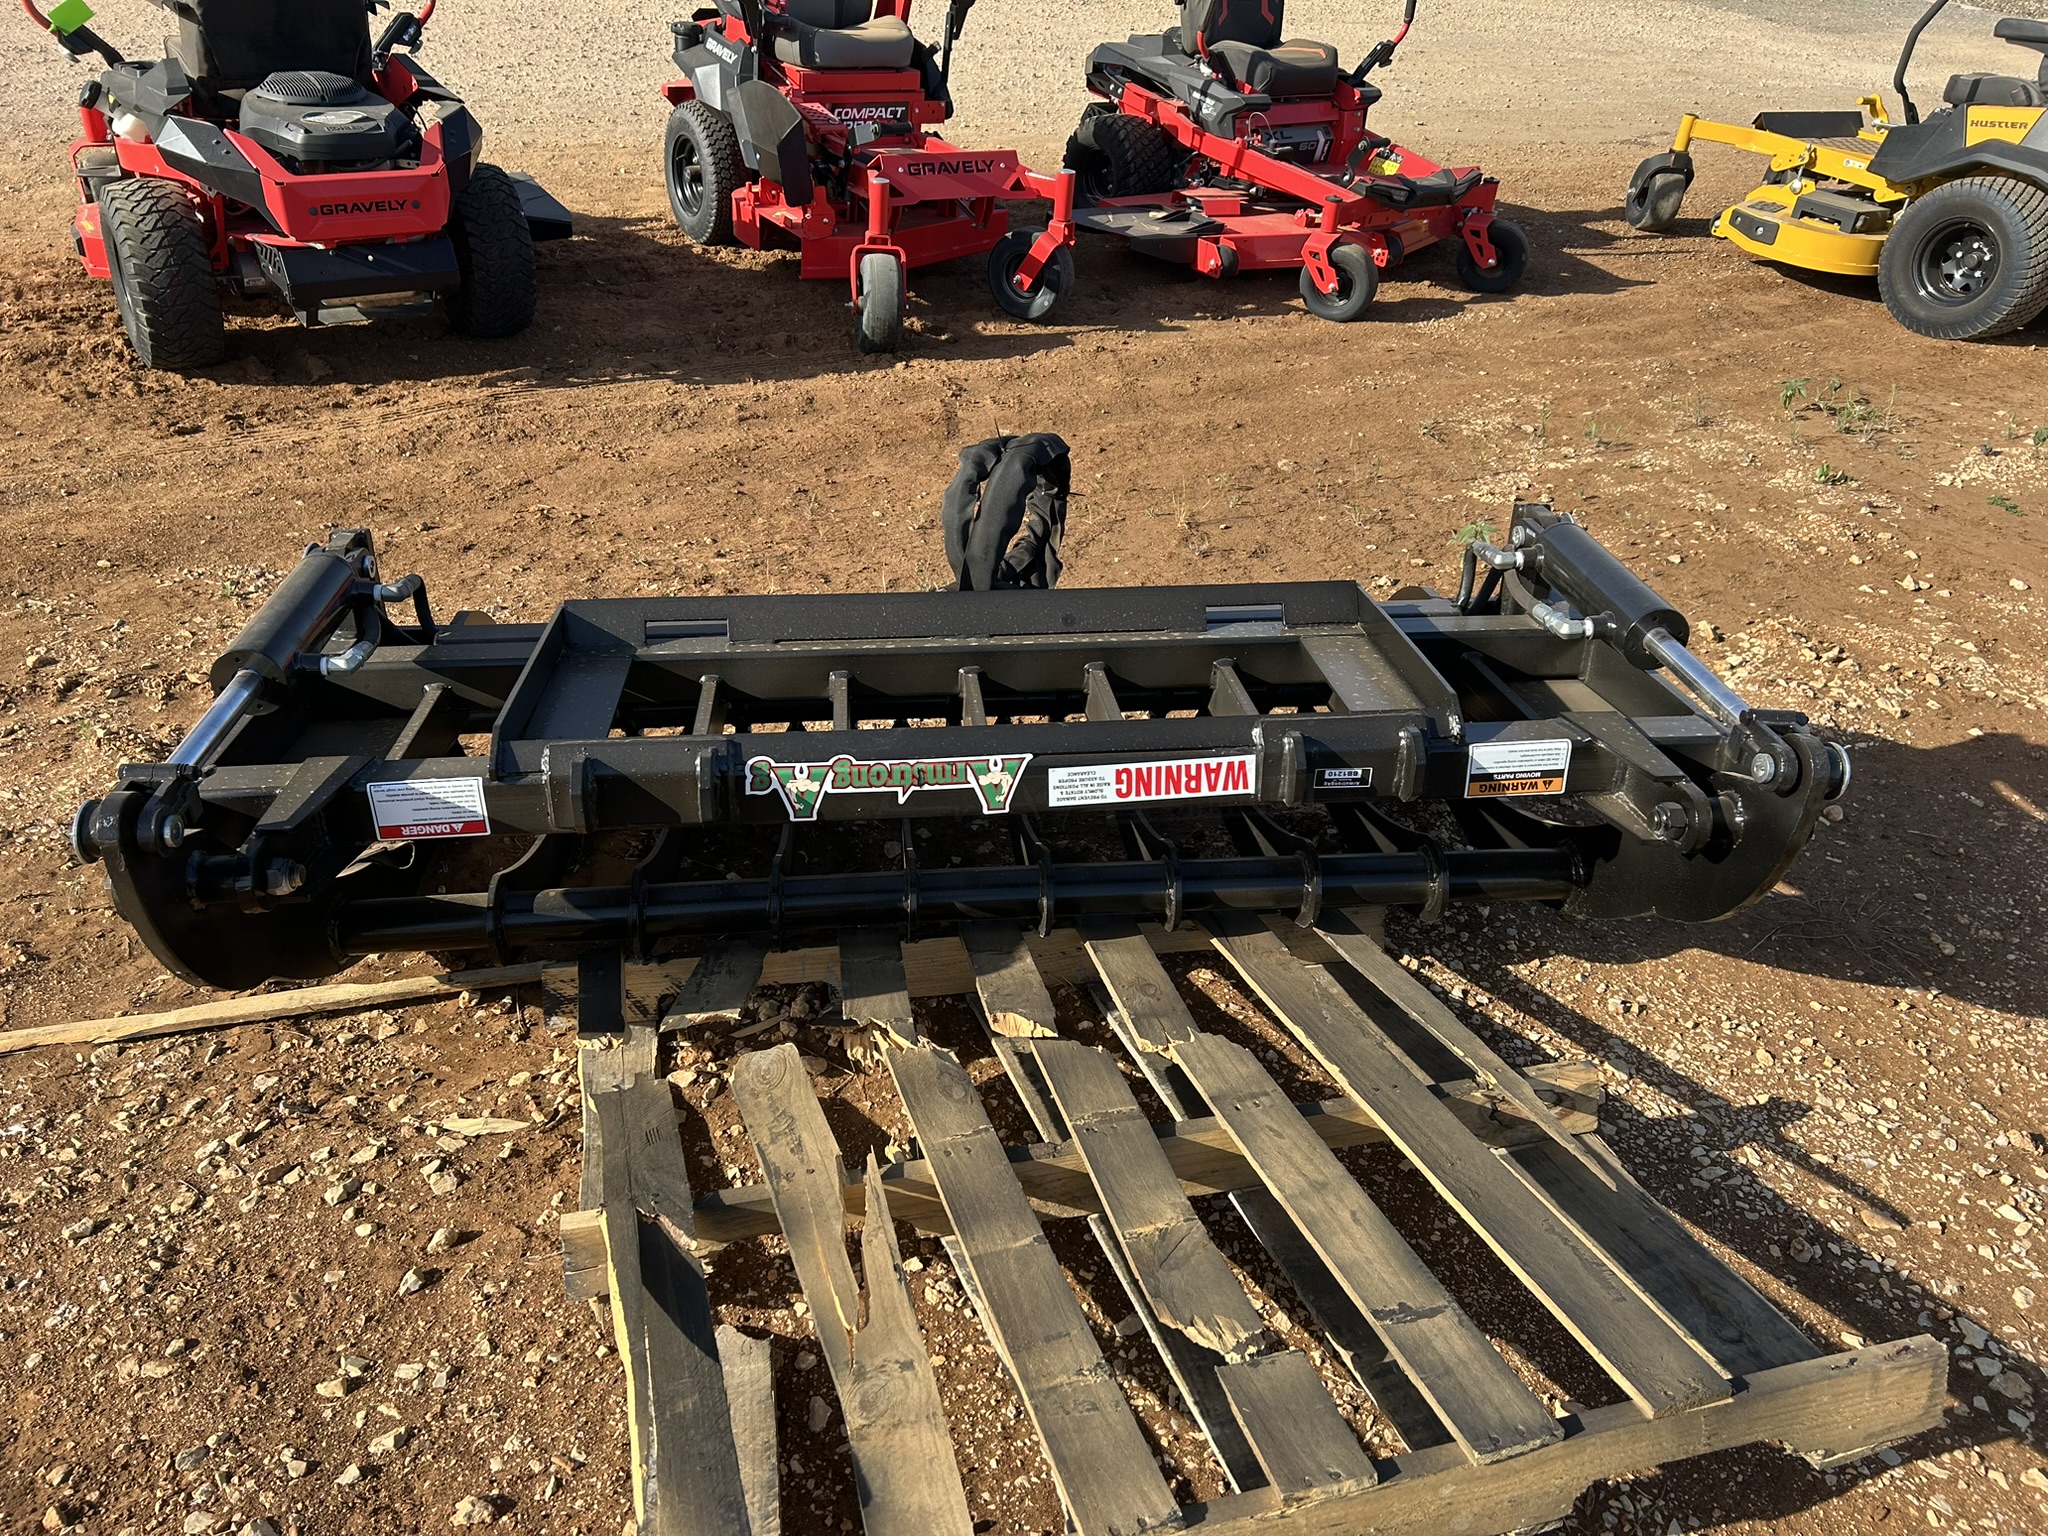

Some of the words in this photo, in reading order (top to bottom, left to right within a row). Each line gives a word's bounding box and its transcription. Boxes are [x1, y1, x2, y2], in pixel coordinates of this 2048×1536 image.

[705, 37, 738, 64] GRAVELY
[834, 106, 906, 120] COMPACT
[1969, 119, 2029, 130] HUSTLER
[906, 159, 996, 177] GRAVELY
[319, 199, 409, 216] GRAVELY
[1115, 760, 1249, 799] WARNING
[1478, 780, 1539, 793] WARNING
[400, 823, 450, 835] DANGER
